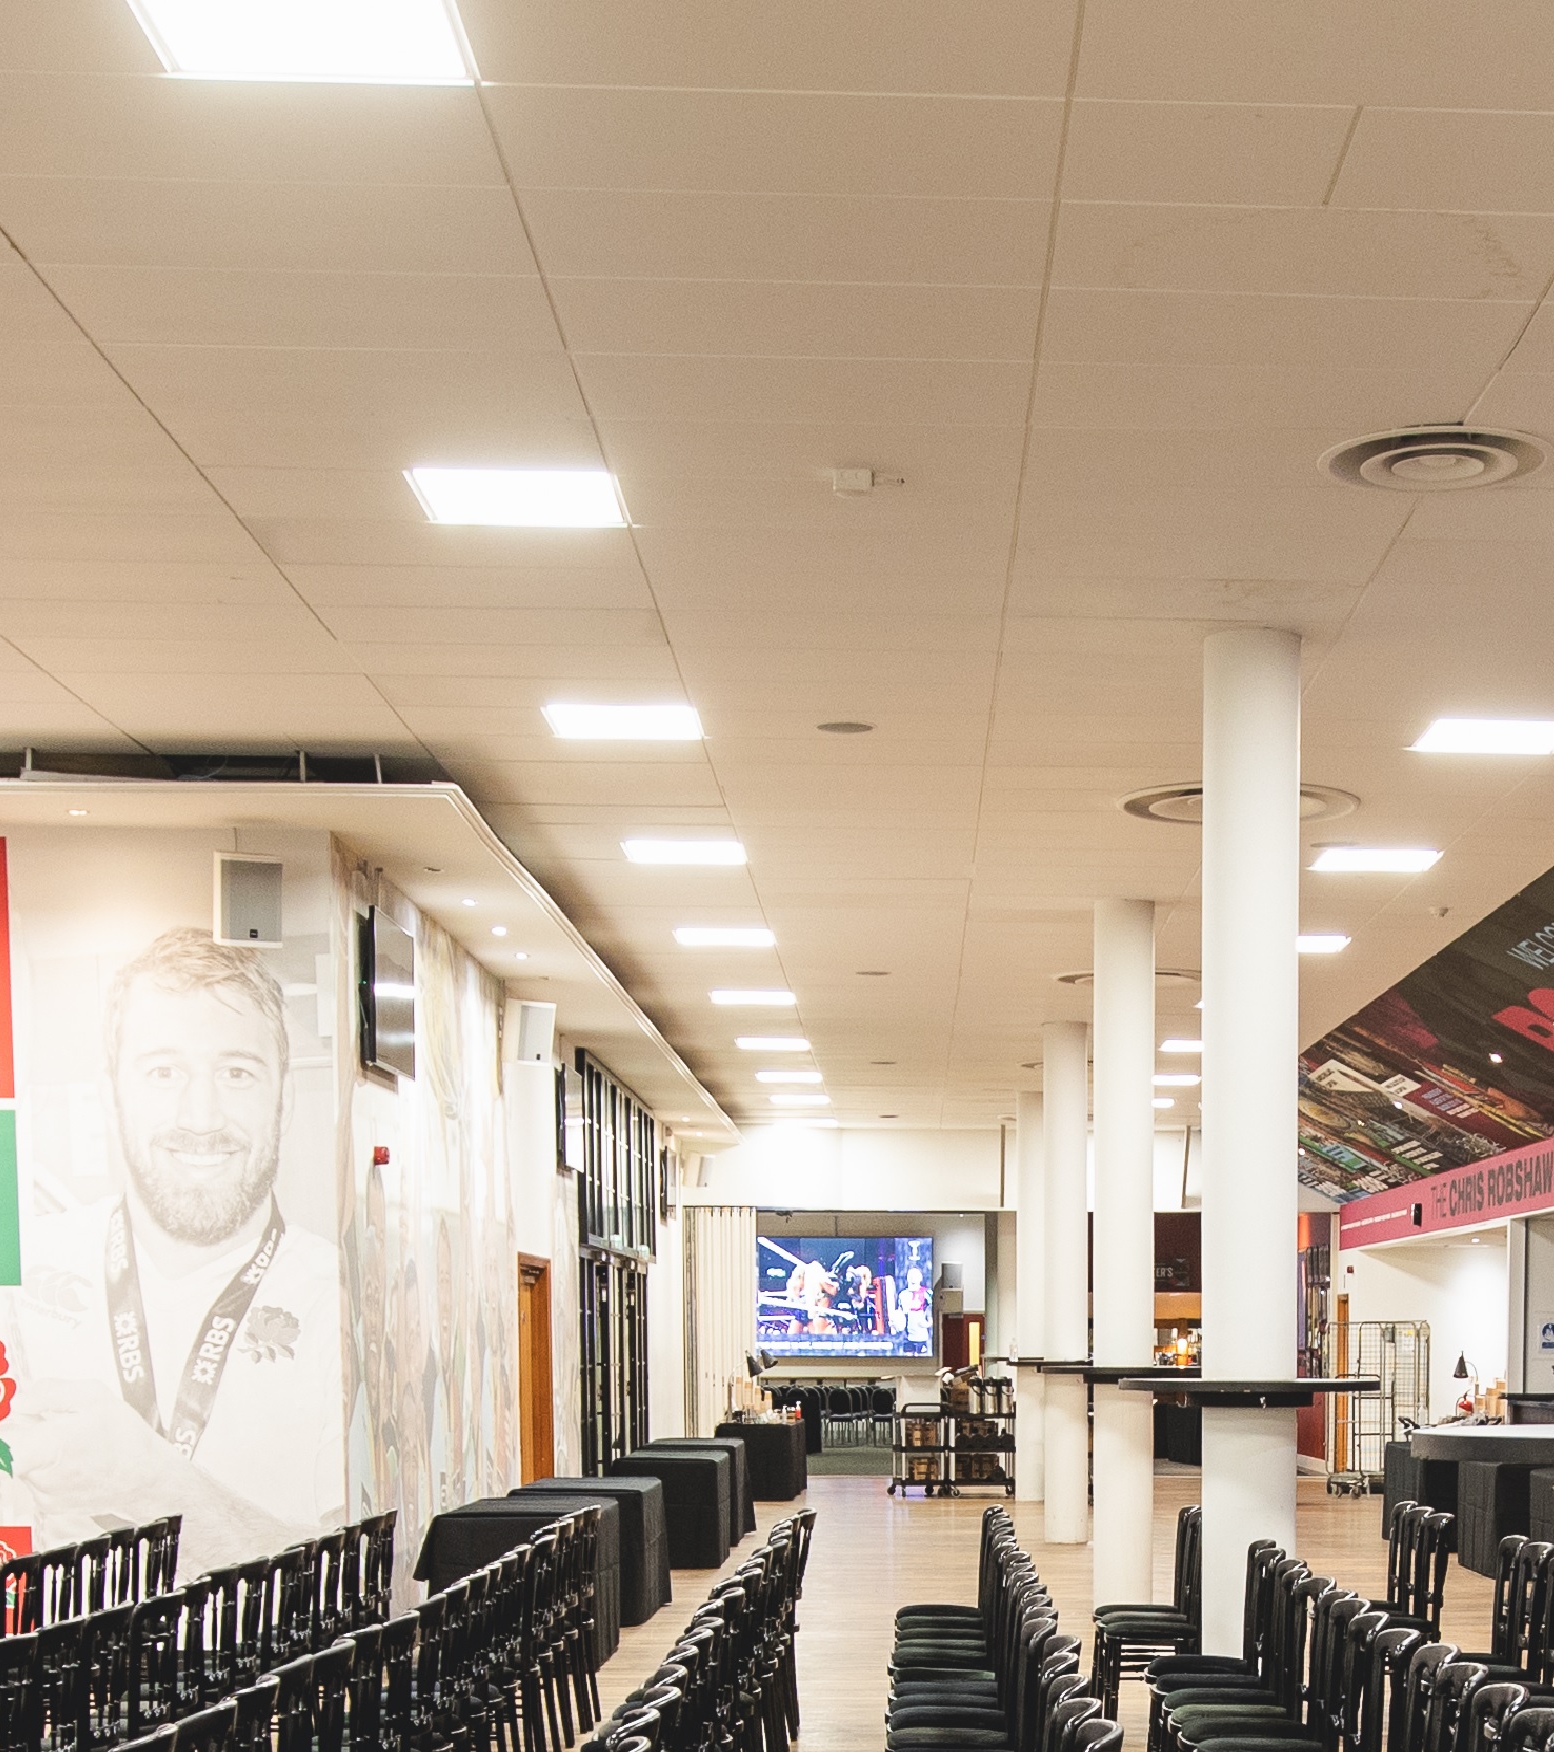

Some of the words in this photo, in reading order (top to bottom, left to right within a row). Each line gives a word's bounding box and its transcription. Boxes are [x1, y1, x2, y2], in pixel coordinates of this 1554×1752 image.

[1449, 1171, 1484, 1217] CHRIS
[1487, 1152, 1554, 1207] ROBSHAW
[117, 1337, 144, 1384] RBS
[198, 1316, 238, 1362] RBS
